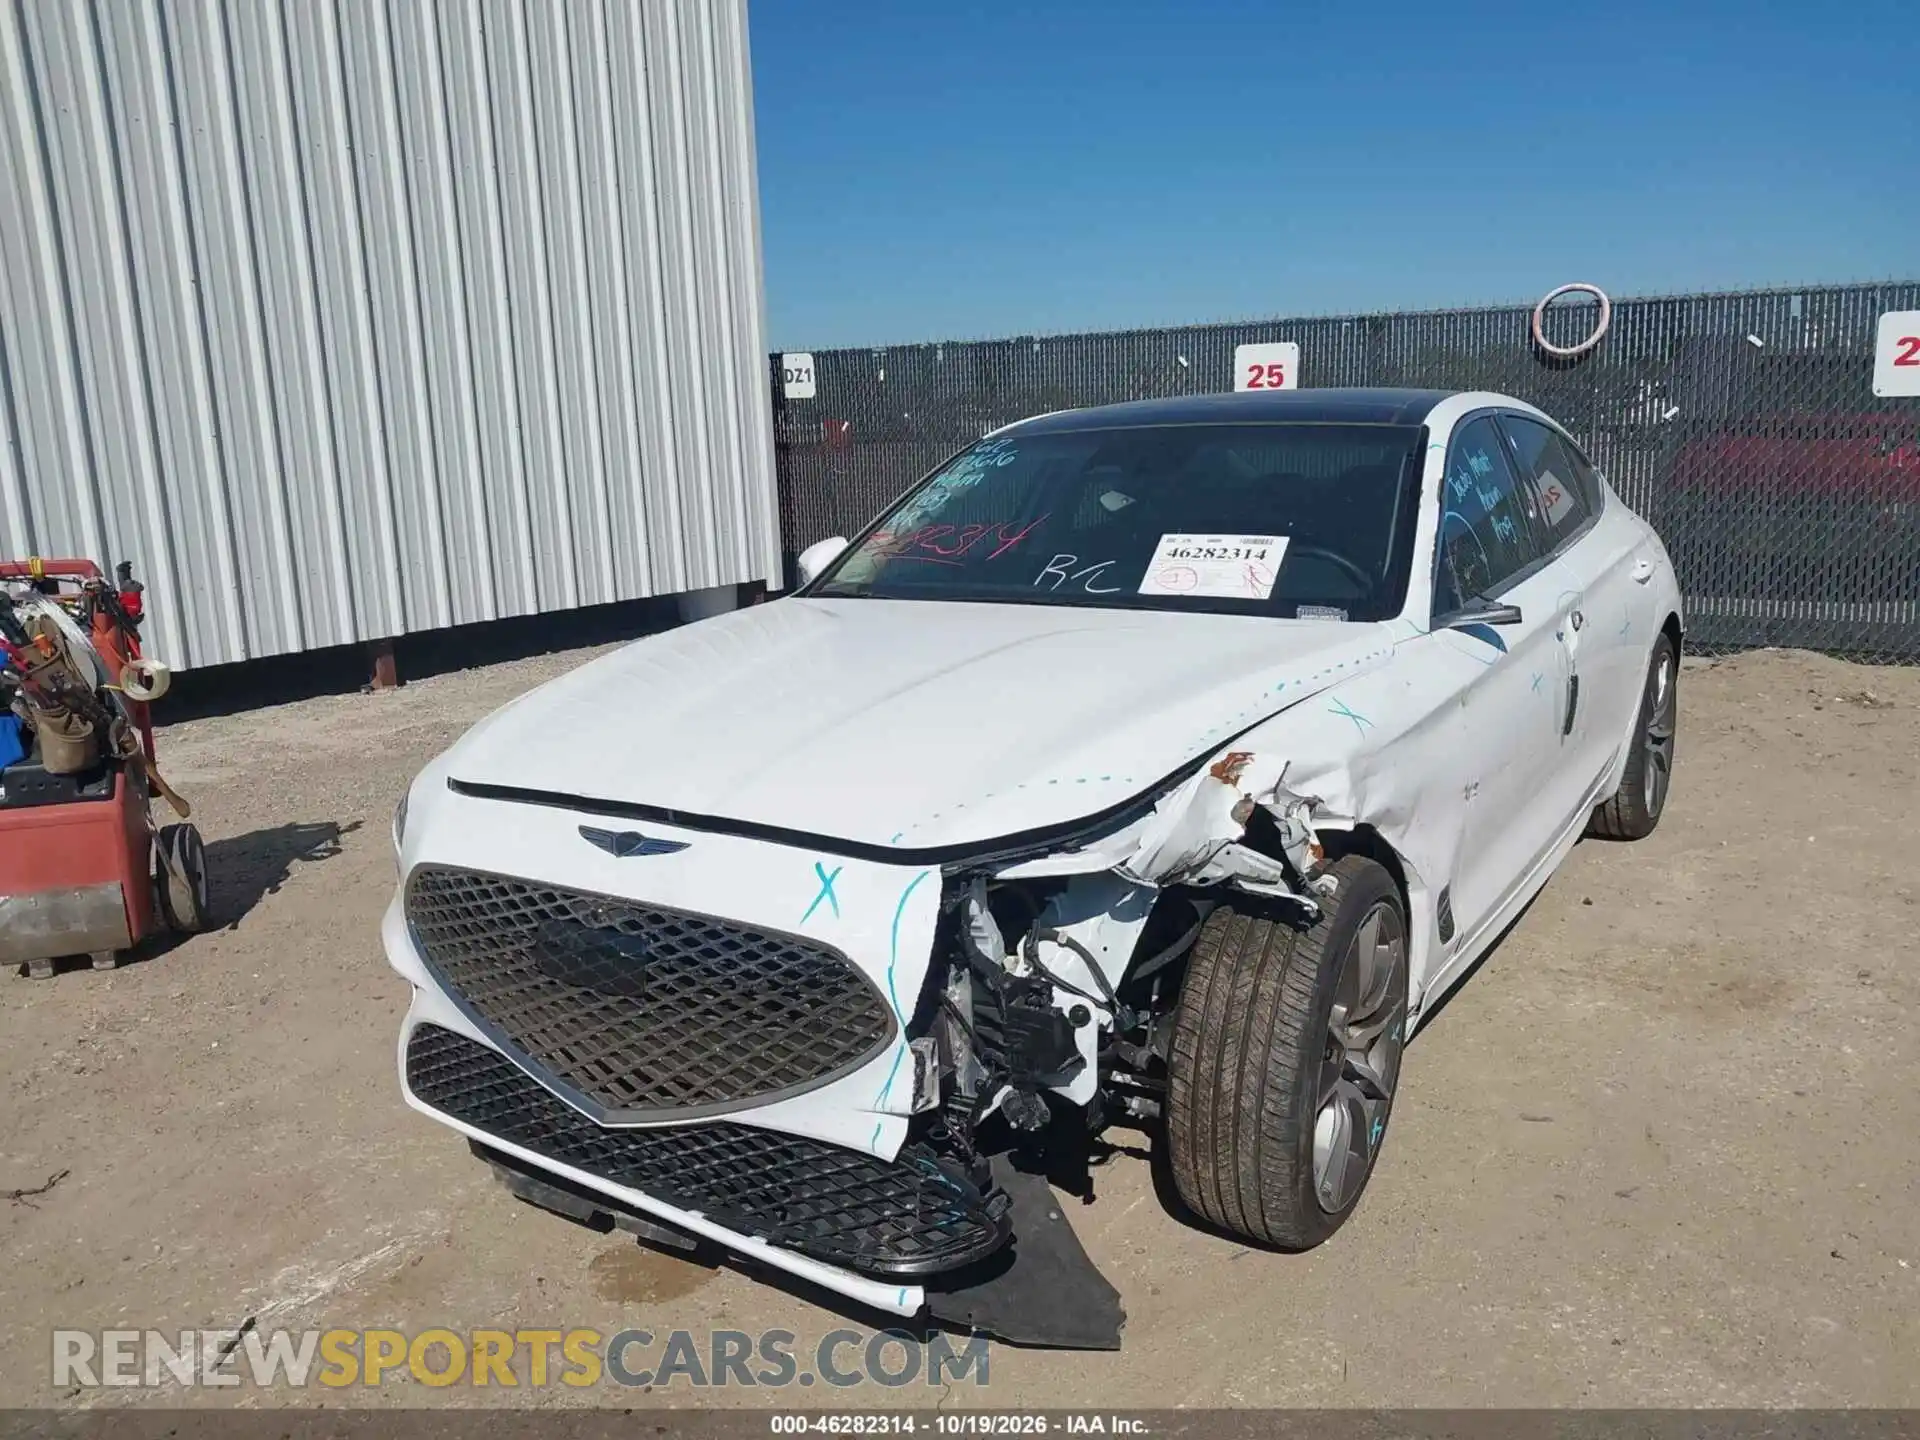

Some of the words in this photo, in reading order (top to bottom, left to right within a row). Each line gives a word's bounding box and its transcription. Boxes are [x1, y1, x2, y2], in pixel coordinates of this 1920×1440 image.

[784, 367, 812, 384] DZ1
[1246, 364, 1285, 389] 25
[1166, 546, 1269, 561] 46282314
